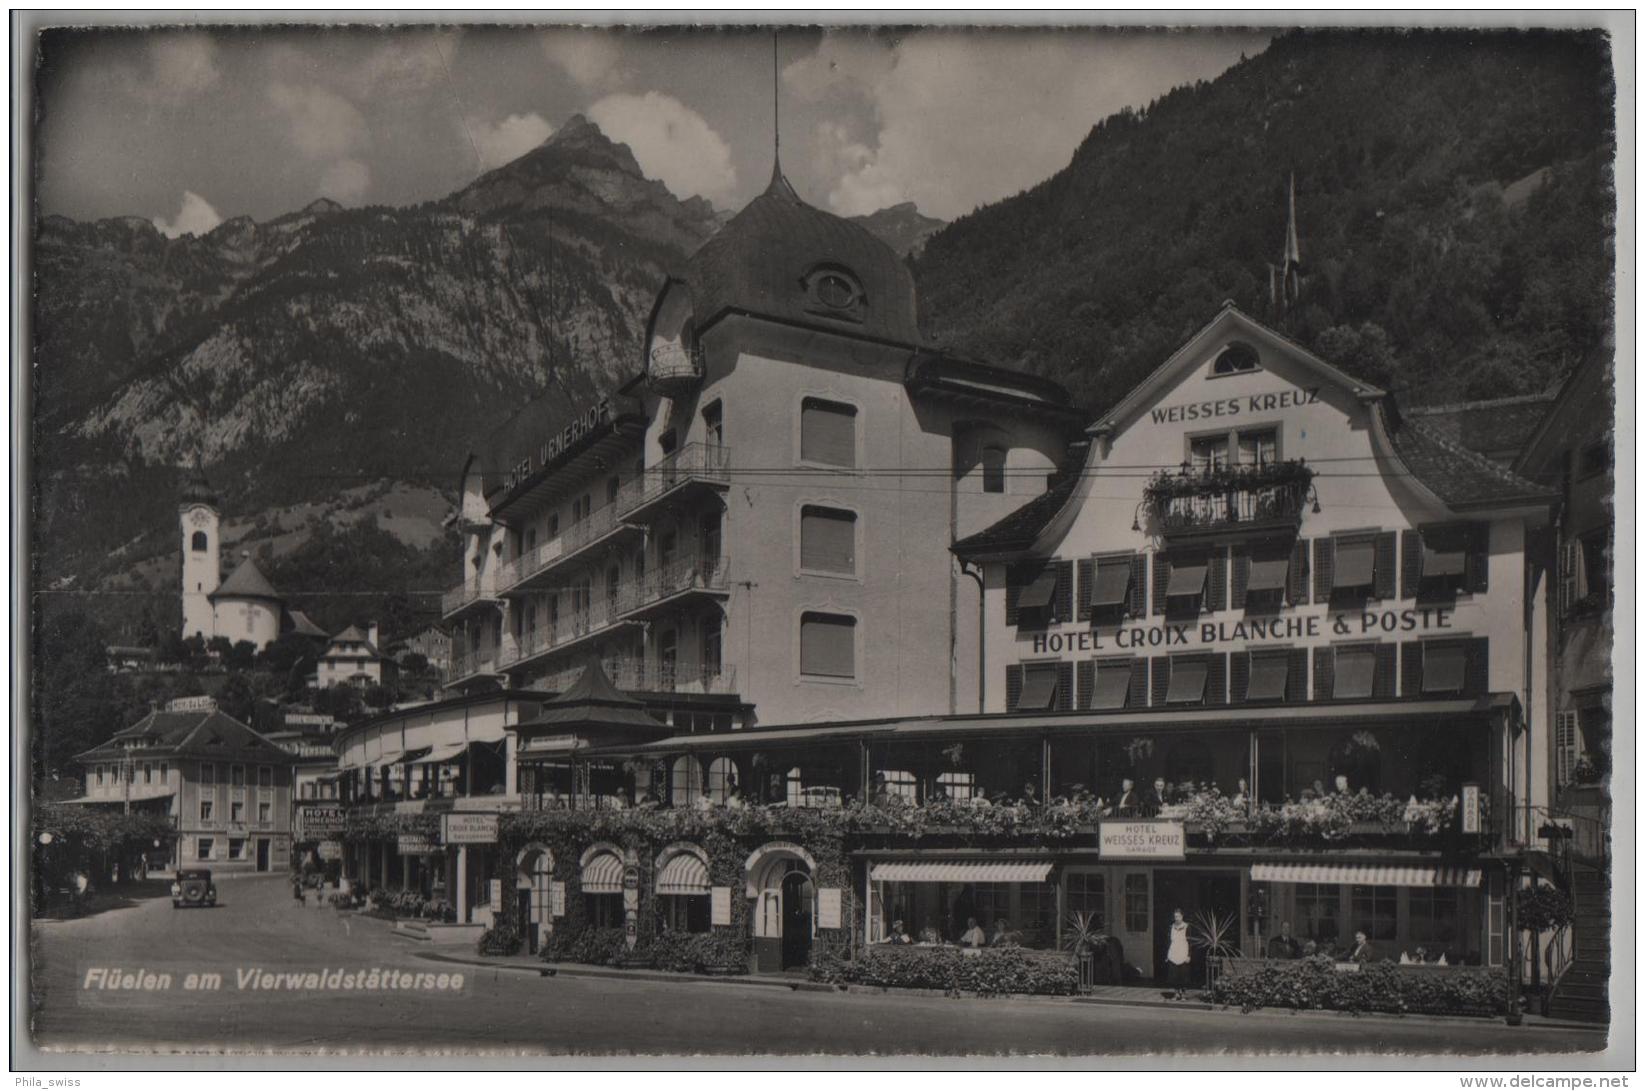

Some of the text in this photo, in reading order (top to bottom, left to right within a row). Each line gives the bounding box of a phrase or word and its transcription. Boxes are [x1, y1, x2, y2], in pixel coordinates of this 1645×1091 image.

[1151, 387, 1321, 425] WEISSES KREUZ
[503, 398, 609, 495] HOTEL URNERHOF
[1033, 607, 1452, 653] HOTEL CROIX BLANCHE & POSTE
[305, 809, 345, 817] HOTEL
[463, 816, 485, 824] HOTEL
[1466, 787, 1475, 830] GARAGE
[1104, 834, 1180, 846] WEISSES KREUZ
[1125, 825, 1157, 834] HOTEL
